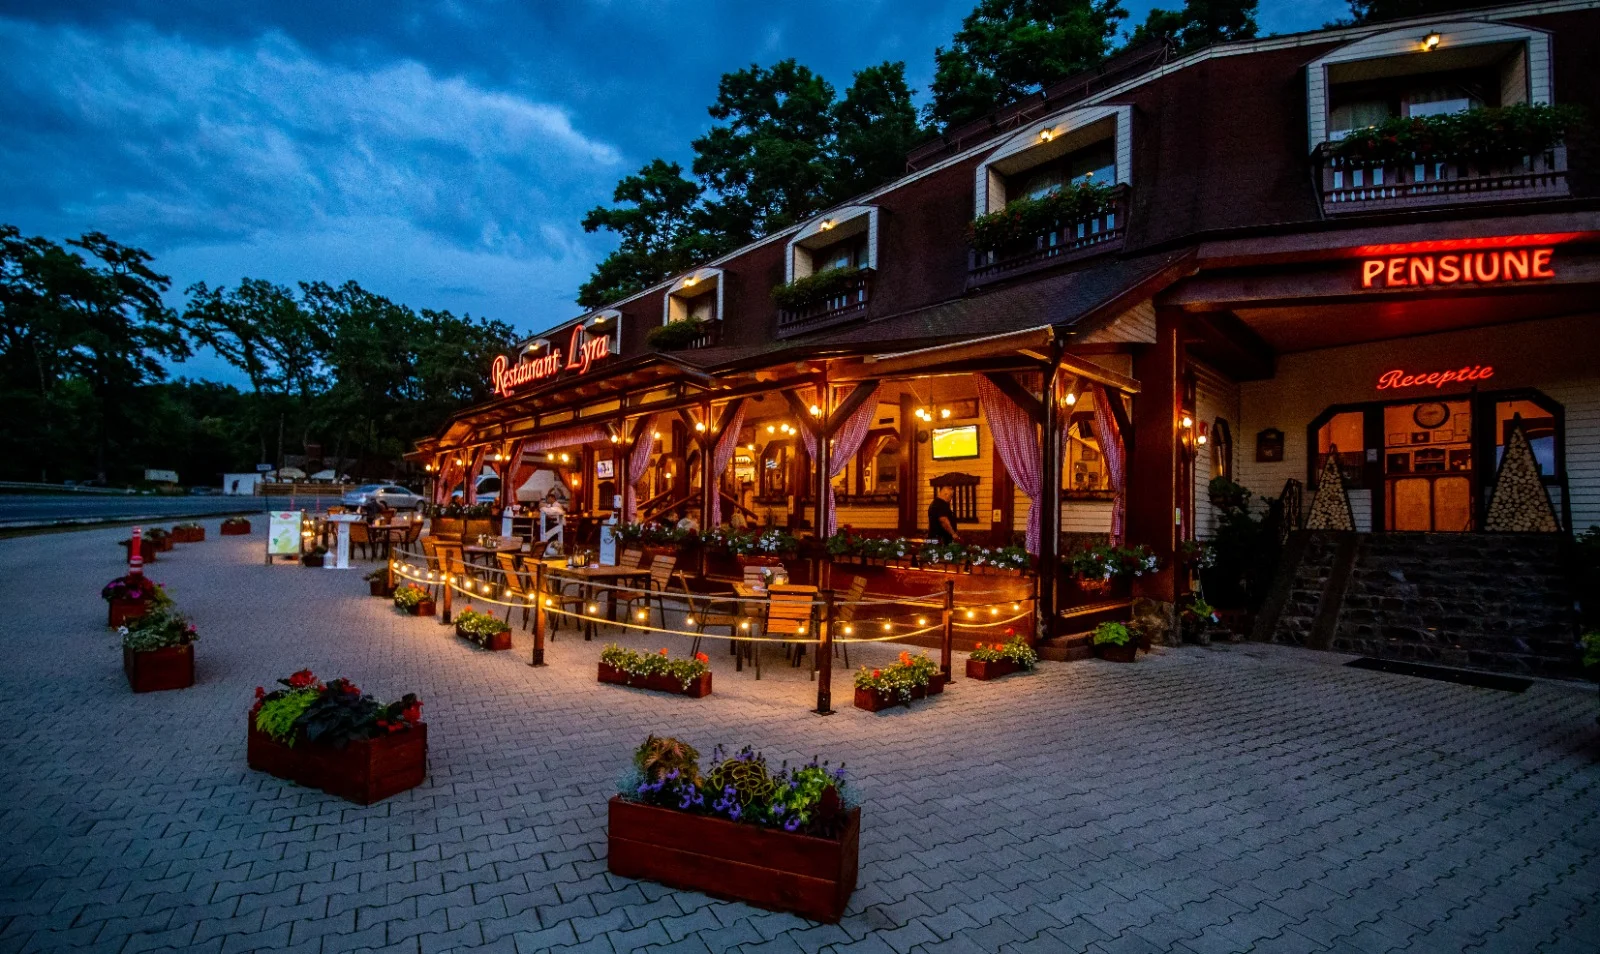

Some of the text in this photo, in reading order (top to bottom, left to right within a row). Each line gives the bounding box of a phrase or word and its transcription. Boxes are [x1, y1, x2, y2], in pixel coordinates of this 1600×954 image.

[1362, 249, 1555, 288] PENSIUNE
[492, 324, 610, 398] Restaurant Lyra
[1376, 365, 1494, 390] Receptie
